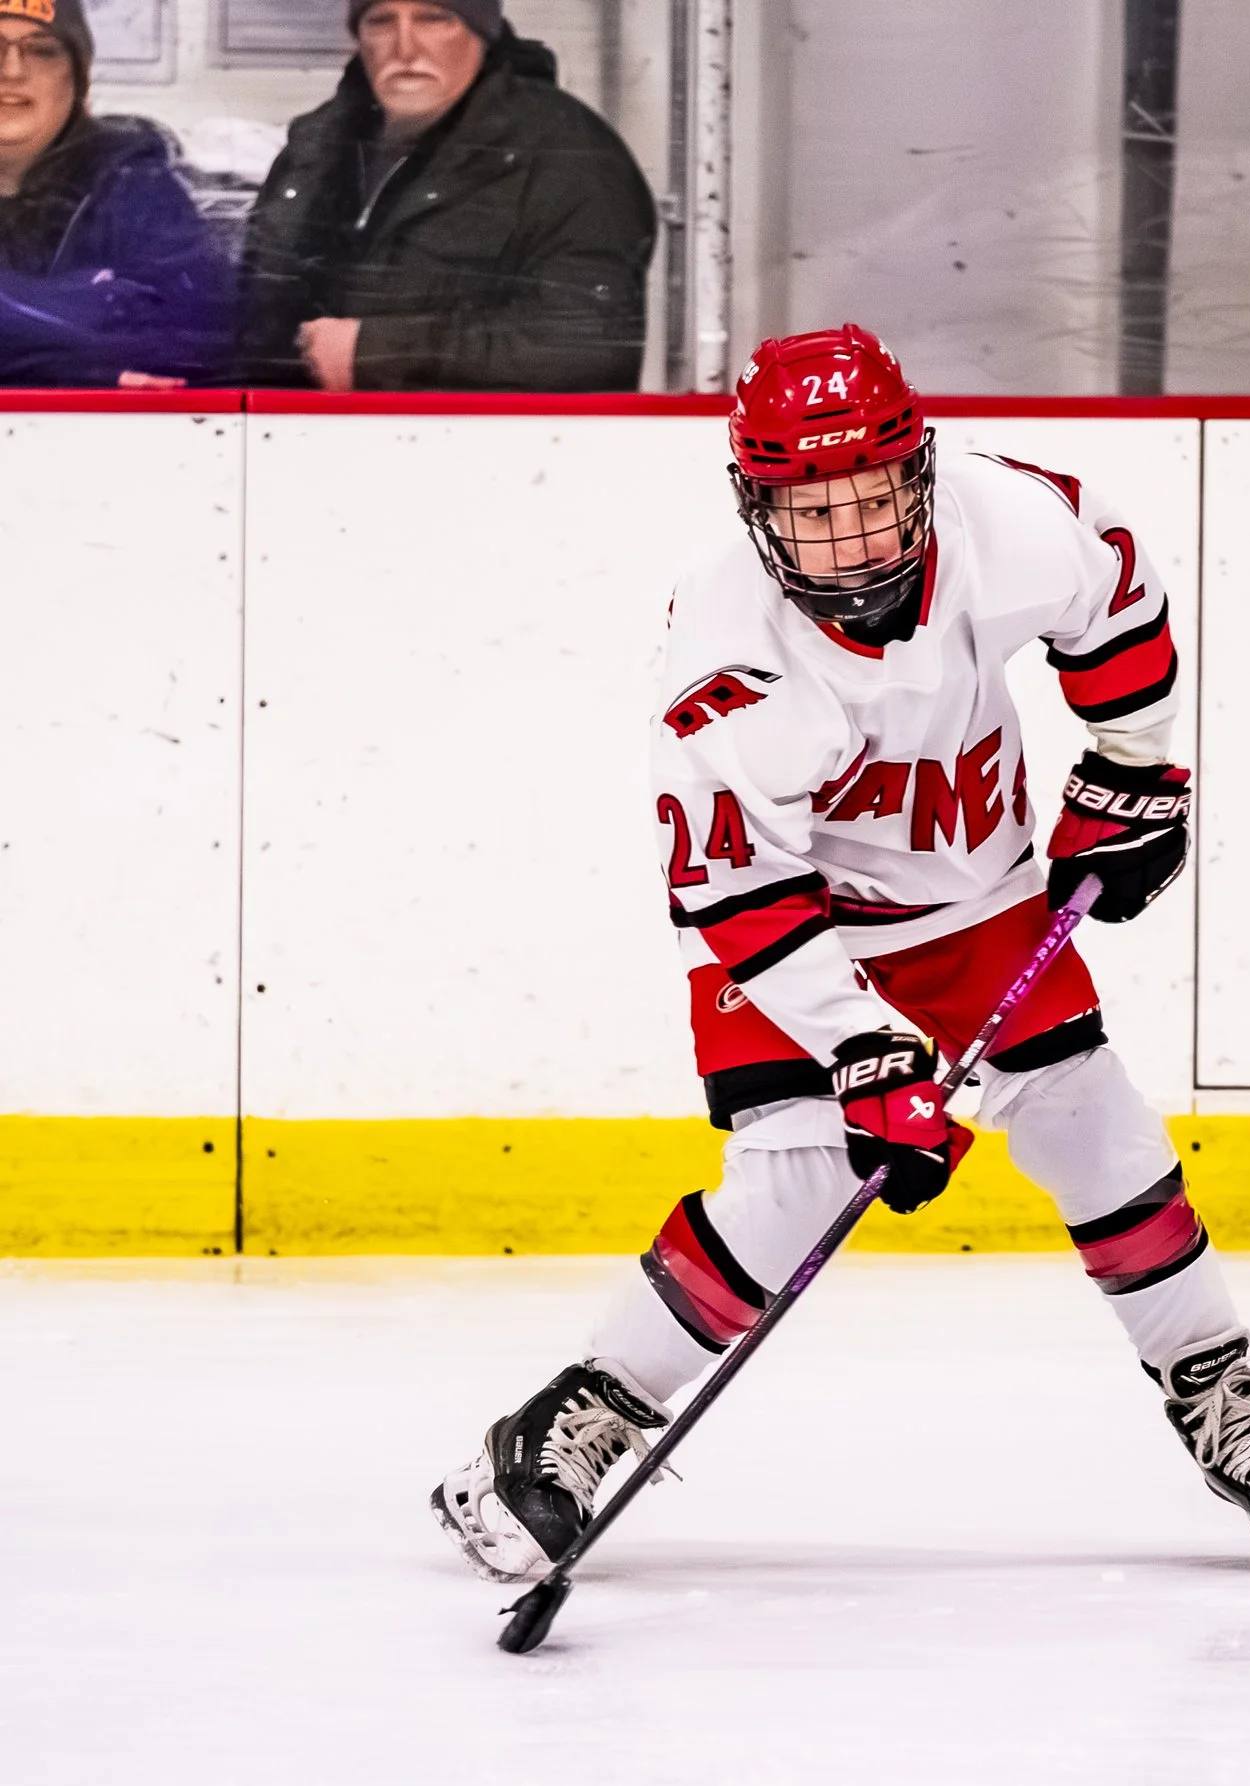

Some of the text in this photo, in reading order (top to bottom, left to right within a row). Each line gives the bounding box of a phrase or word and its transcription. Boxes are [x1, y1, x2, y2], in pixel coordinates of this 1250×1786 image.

[802, 371, 849, 406] 24
[798, 426, 867, 451] CCM
[656, 789, 756, 889] 24
[832, 1051, 915, 1097] UER
